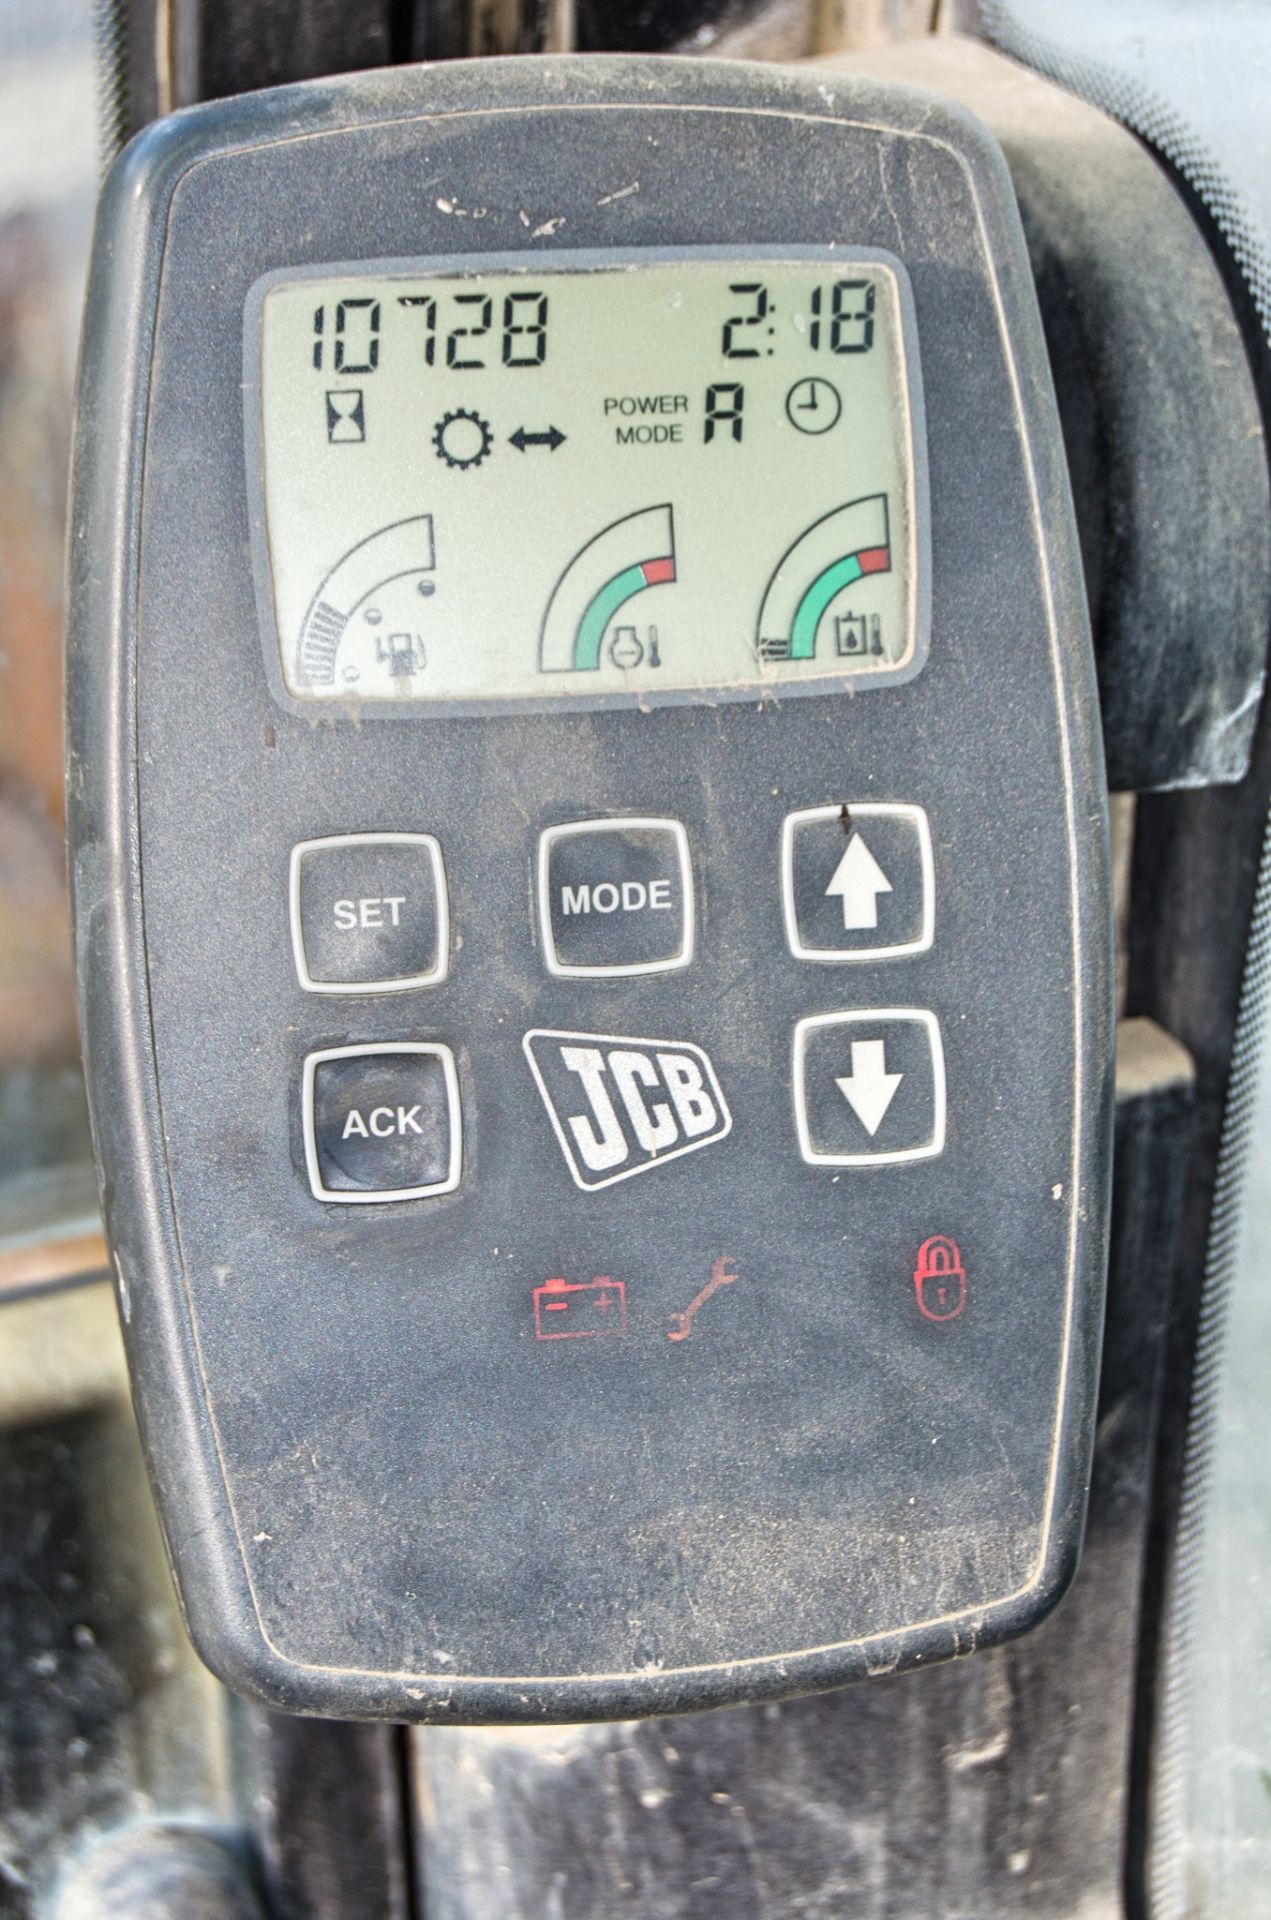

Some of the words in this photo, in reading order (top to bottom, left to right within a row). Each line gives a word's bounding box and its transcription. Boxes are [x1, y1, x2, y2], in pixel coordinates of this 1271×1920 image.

[313, 291, 549, 374] 10728
[721, 279, 877, 359] 2:18
[604, 395, 690, 418] POWER
[703, 382, 745, 446] A
[615, 423, 684, 446] MODE
[333, 896, 406, 930] SET
[561, 879, 673, 916] MODE
[341, 1105, 424, 1140] ACK
[560, 1046, 719, 1172] JCB
